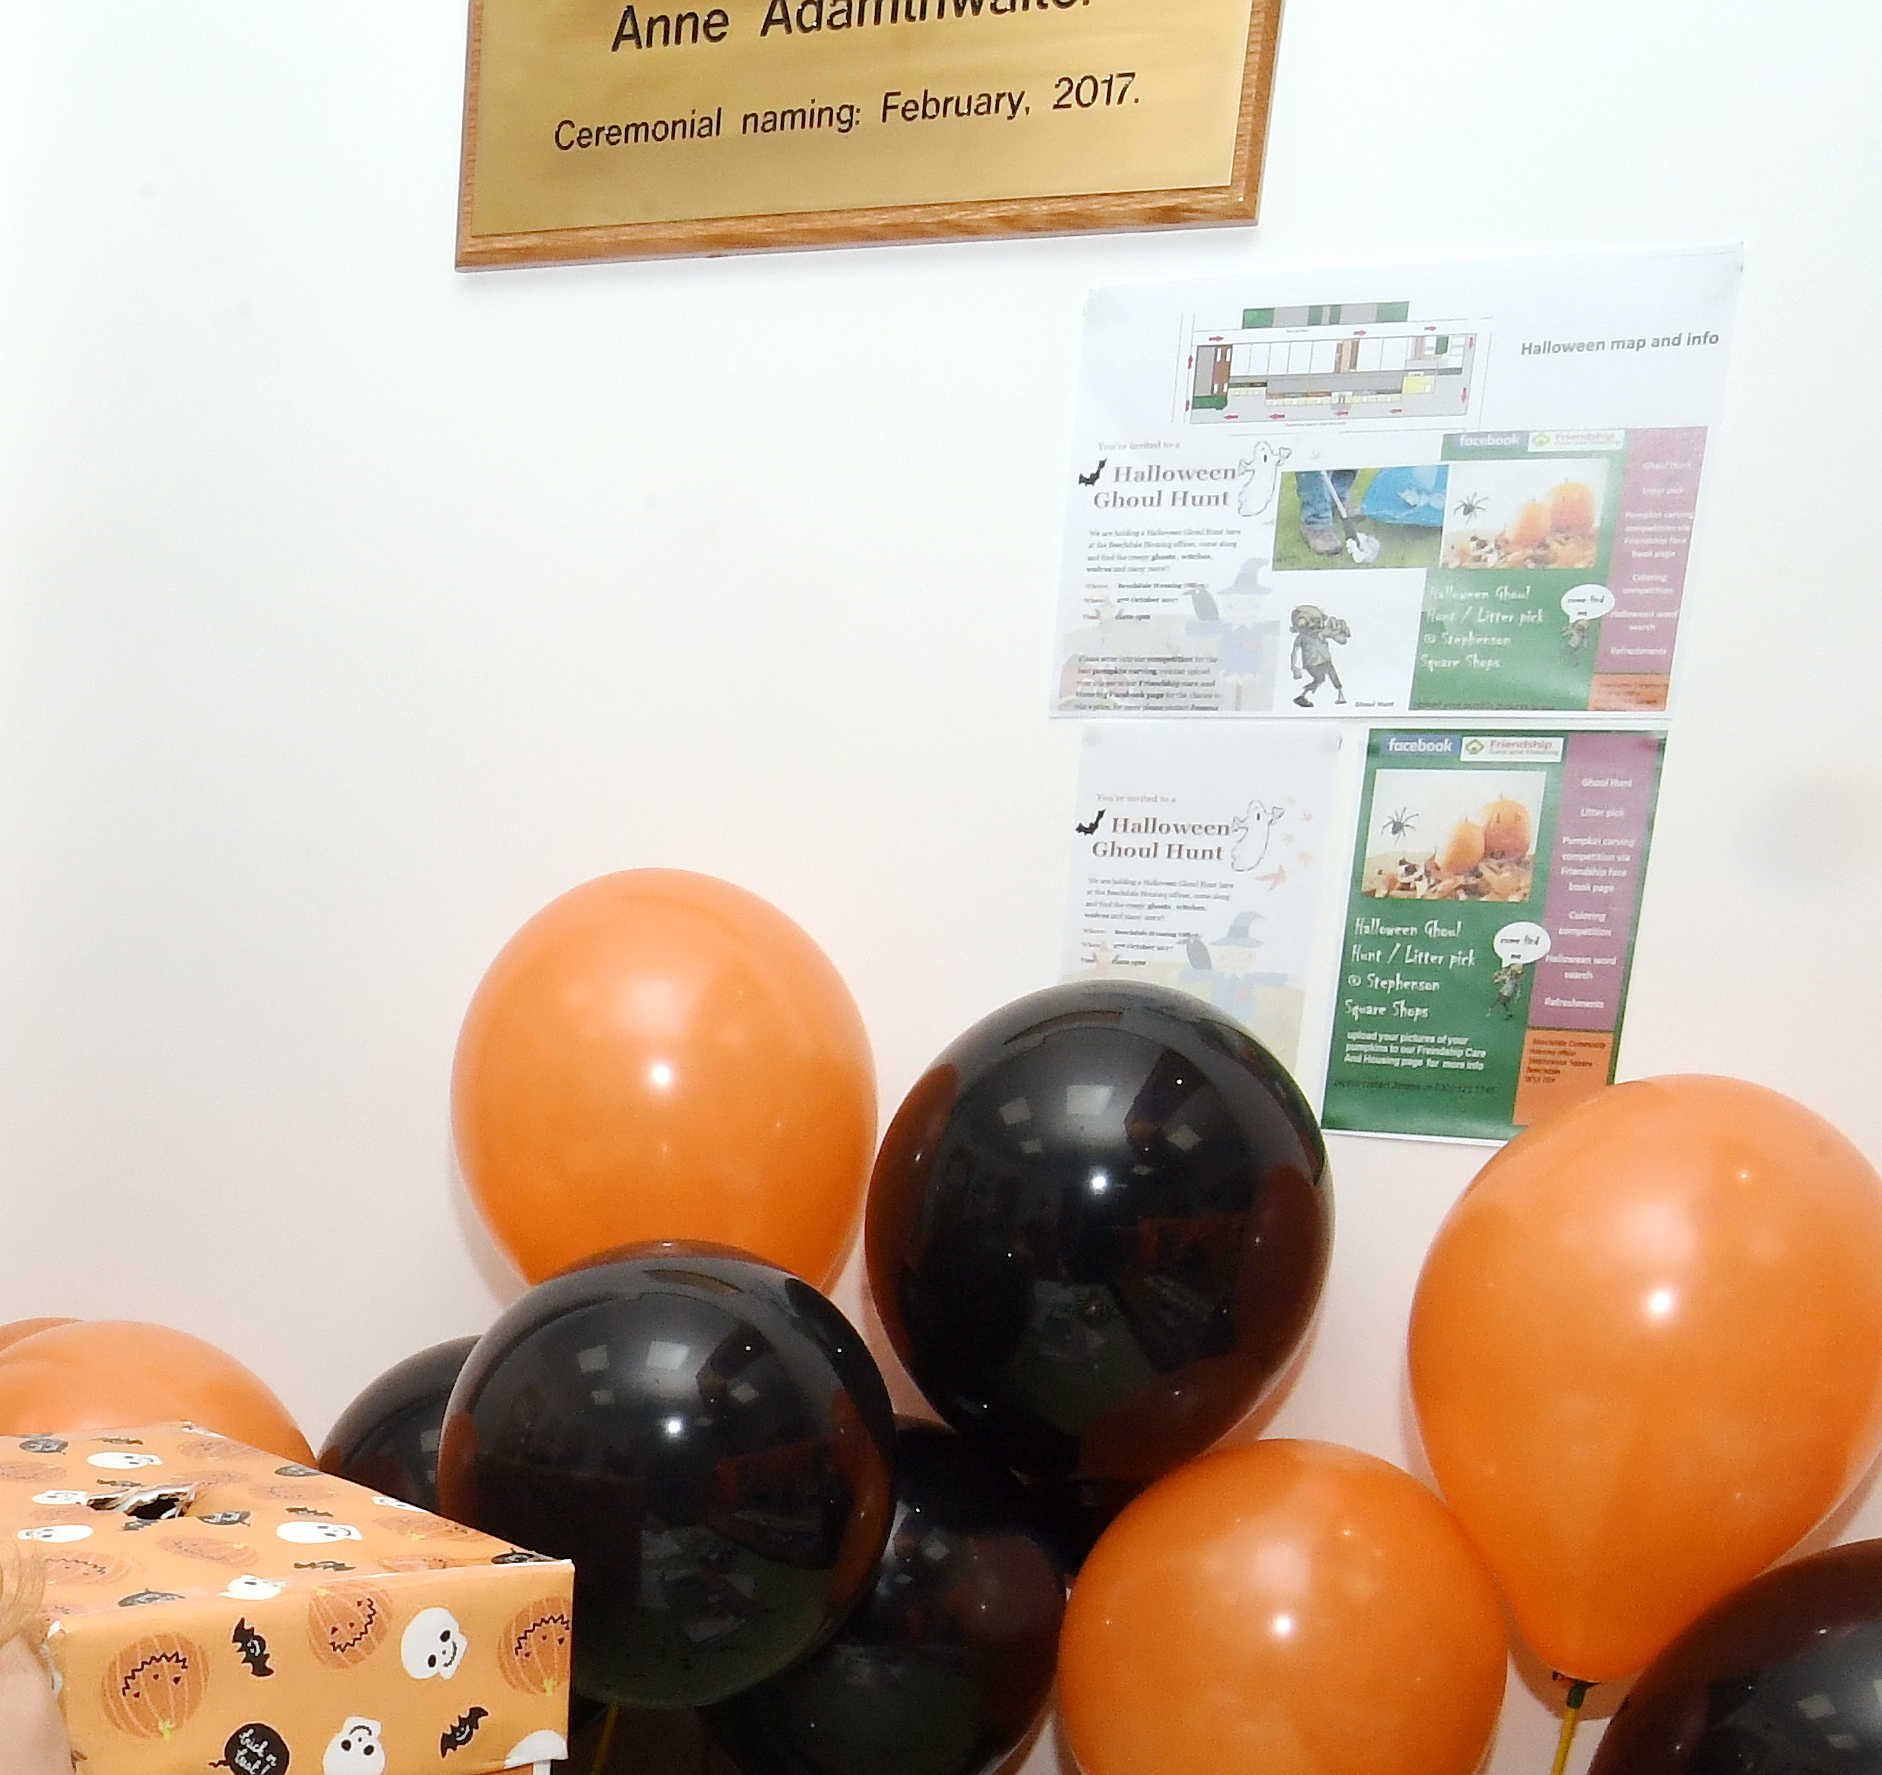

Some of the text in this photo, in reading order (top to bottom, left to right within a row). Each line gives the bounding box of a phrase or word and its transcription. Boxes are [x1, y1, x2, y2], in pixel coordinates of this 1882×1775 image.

[611, 5, 730, 52] Anne
[554, 72, 1139, 151] Ceremonial naming: February, 2017.
[1520, 330, 1719, 355] Halloween map and info
[1129, 440, 1161, 450] invited
[1459, 433, 1519, 447] facebook
[1113, 464, 1236, 483] Halloween
[1093, 490, 1230, 509] Ghoul Hunt
[1495, 584, 1530, 600] Ghoul
[1424, 609, 1455, 624] Hunt
[1477, 607, 1513, 624] Litter
[1519, 608, 1543, 627] pick
[1441, 631, 1512, 648] Stephenson
[1420, 653, 1501, 671] Square Shops
[1388, 737, 1552, 752] facebook Friendship
[1127, 793, 1158, 803] invited
[1112, 817, 1230, 836] Halloween
[1092, 841, 1224, 861] Ghoul Hunt
[1355, 917, 1461, 937] Halloween Ghoul
[1351, 944, 1381, 963] Hunt
[1405, 945, 1444, 965] Litter
[1449, 949, 1475, 969] pick
[1367, 973, 1440, 993] Stephenson
[1345, 999, 1428, 1022] Square Shops
